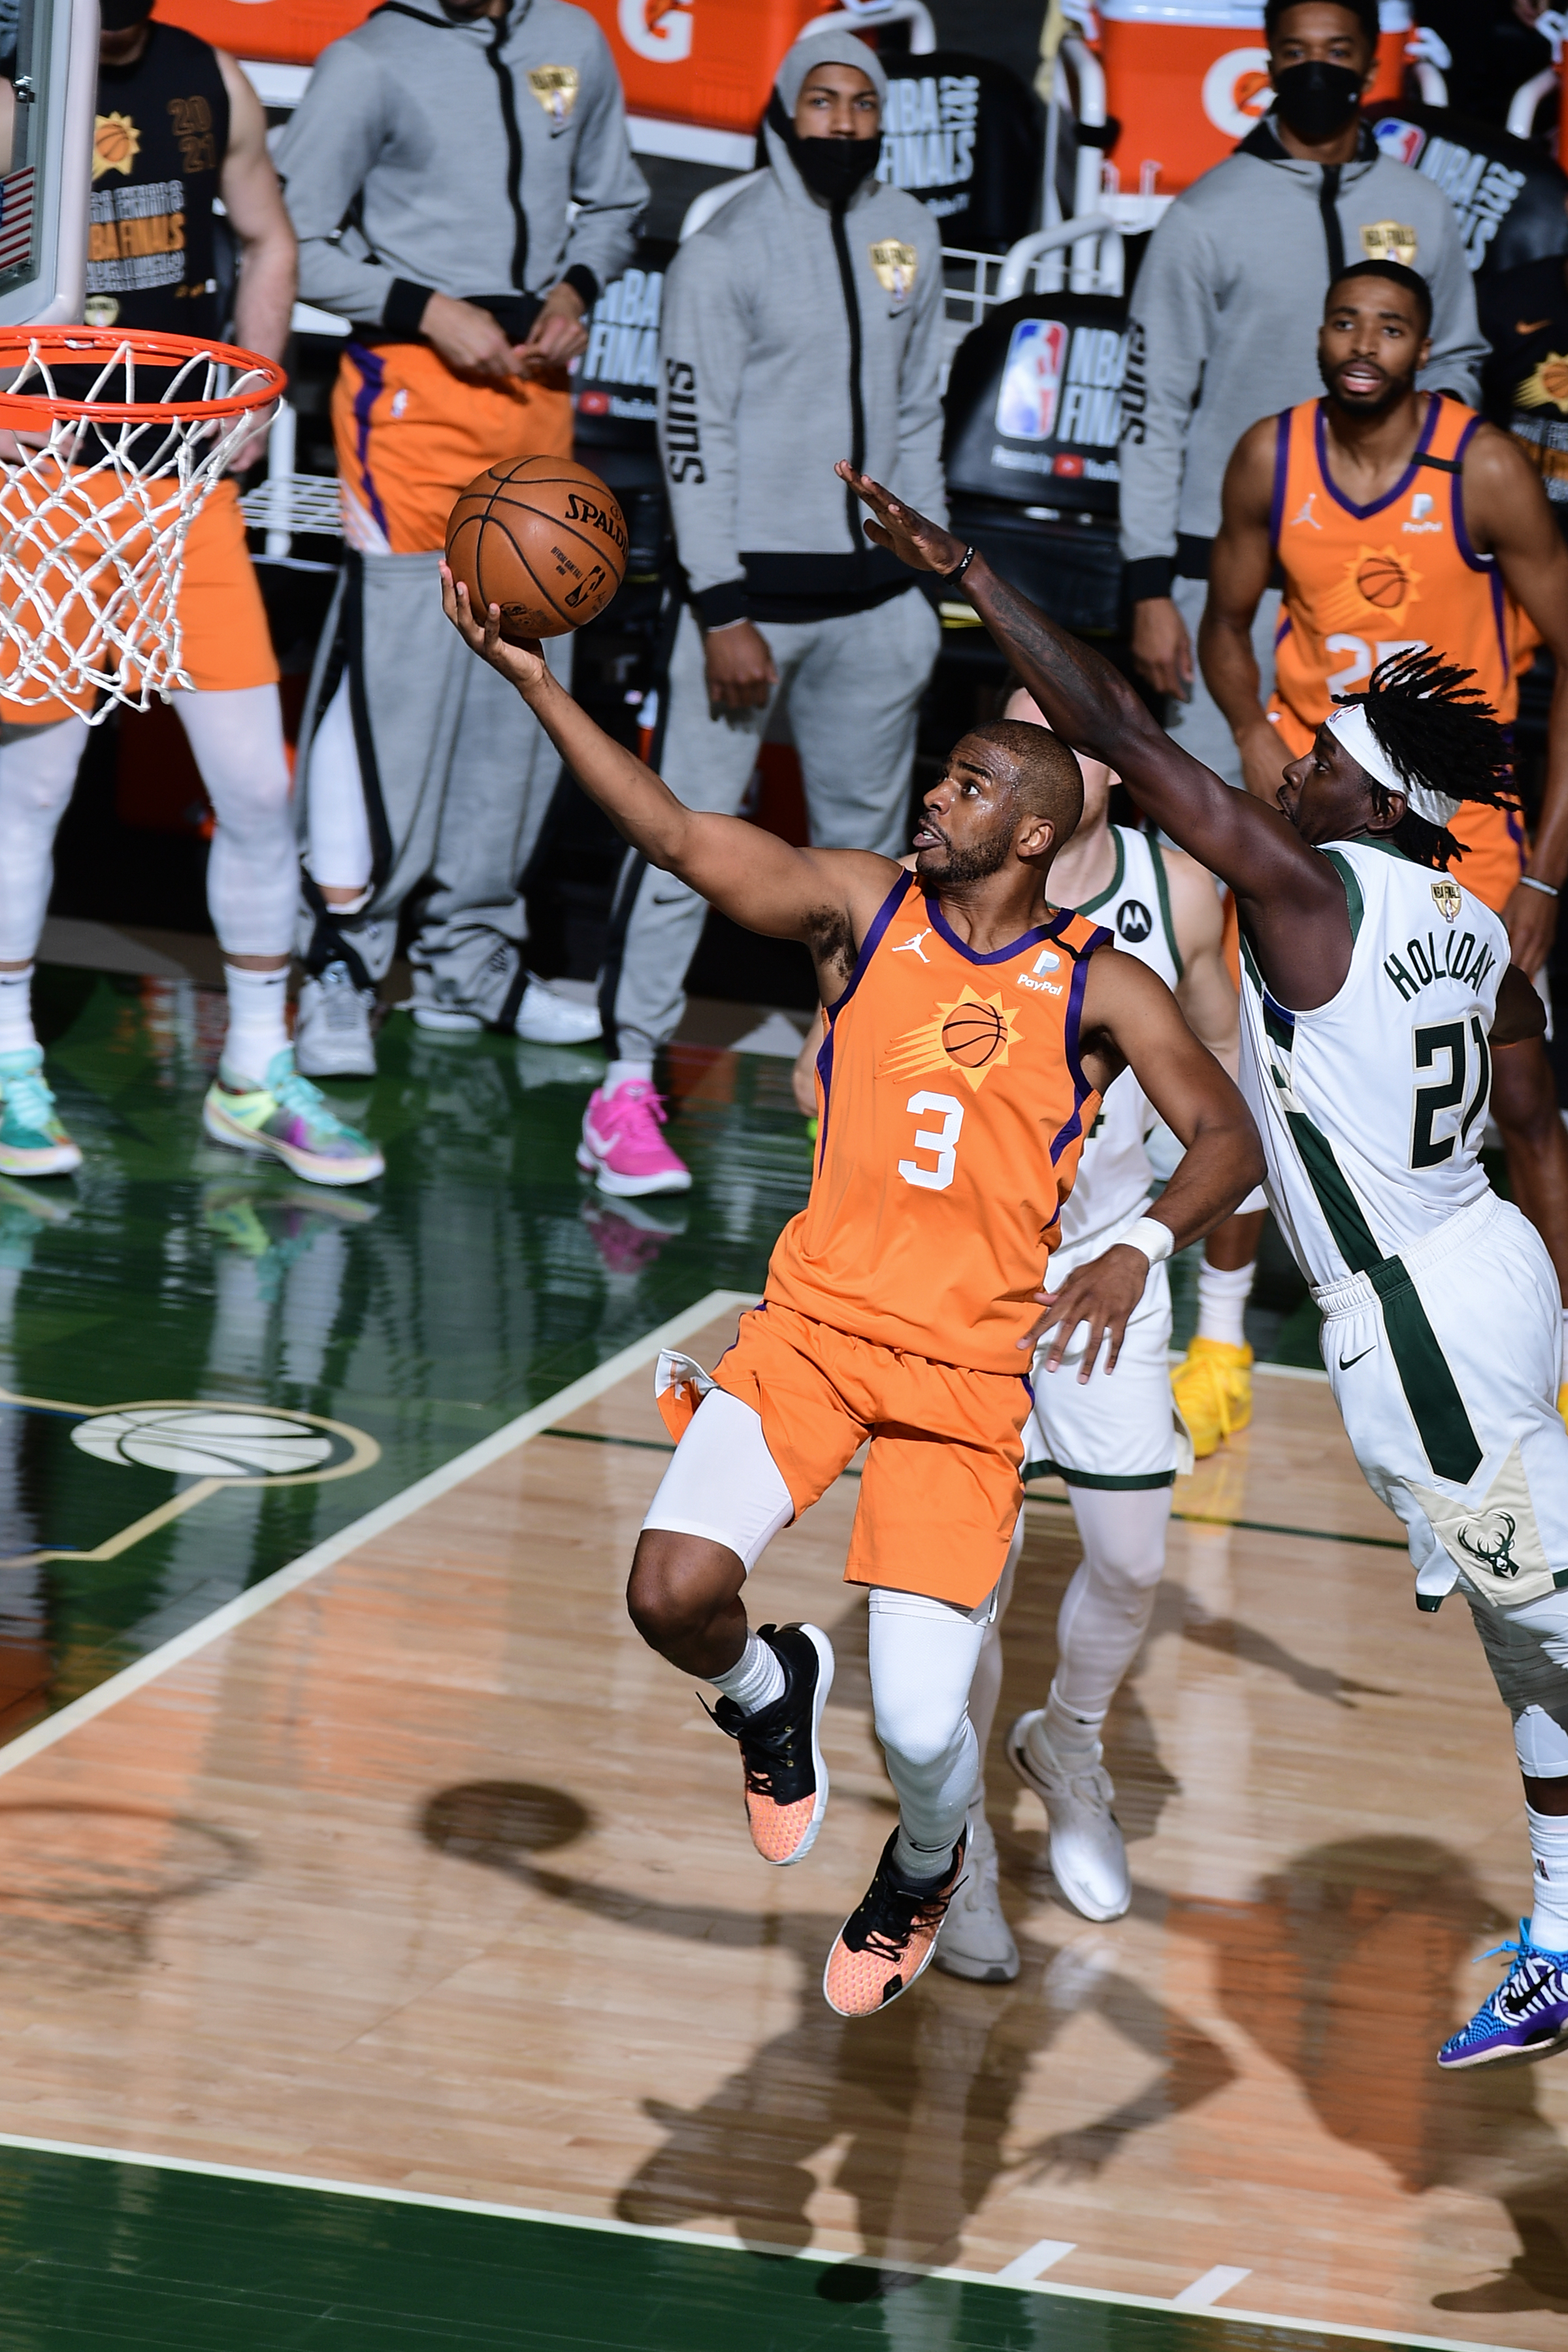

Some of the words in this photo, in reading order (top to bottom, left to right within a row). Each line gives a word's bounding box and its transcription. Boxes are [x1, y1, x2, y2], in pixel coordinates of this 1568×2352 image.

[939, 75, 980, 132] 2021
[875, 131, 974, 188] FINALS
[666, 358, 706, 483] SUNS
[1401, 521, 1443, 534] PayPal
[1017, 973, 1063, 996] PayPal
[1384, 930, 1496, 1002] HOLIDAY
[1409, 1011, 1492, 1171] 21
[898, 1090, 965, 1191] 3
